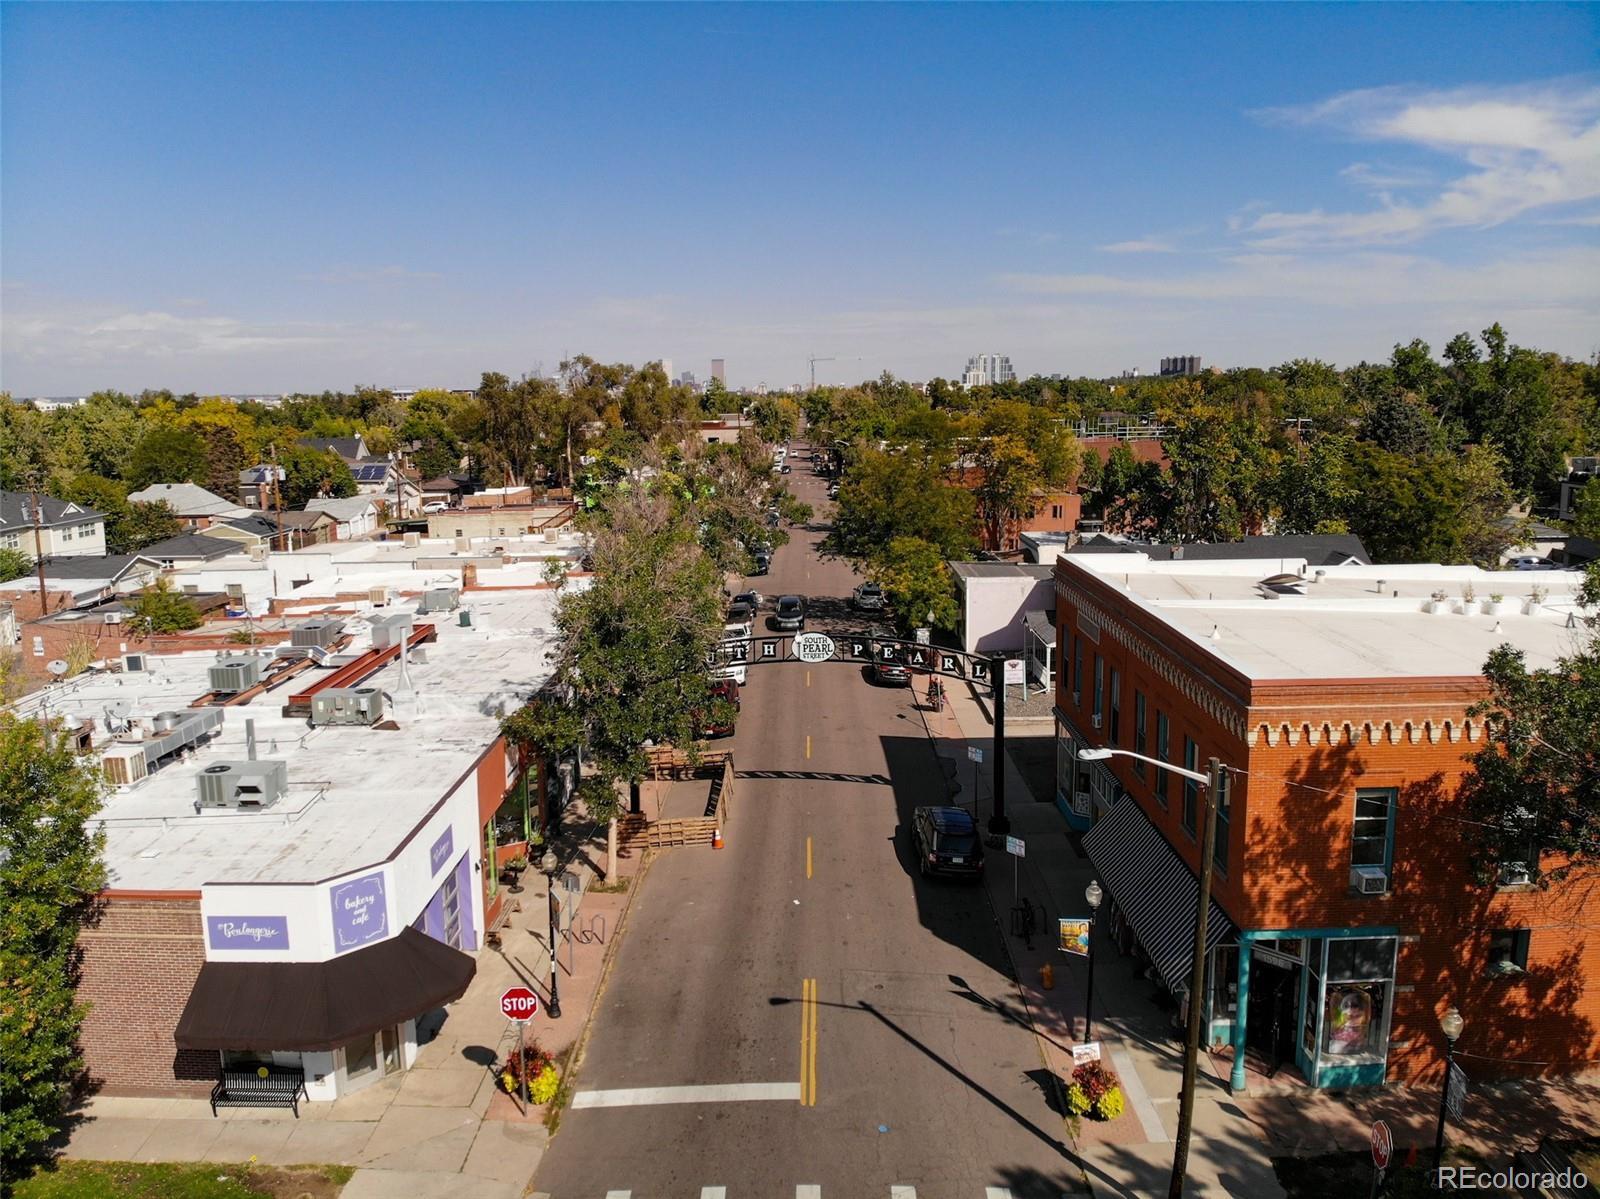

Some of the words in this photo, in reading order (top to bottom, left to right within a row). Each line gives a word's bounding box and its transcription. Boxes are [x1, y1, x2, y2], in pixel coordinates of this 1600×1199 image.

[803, 644, 833, 655] PEARL
[853, 644, 986, 677] PEARL
[345, 895, 375, 910] bakery
[353, 905, 367, 915] and
[503, 997, 535, 1011] STOP
[1372, 1129, 1387, 1159] STOP
